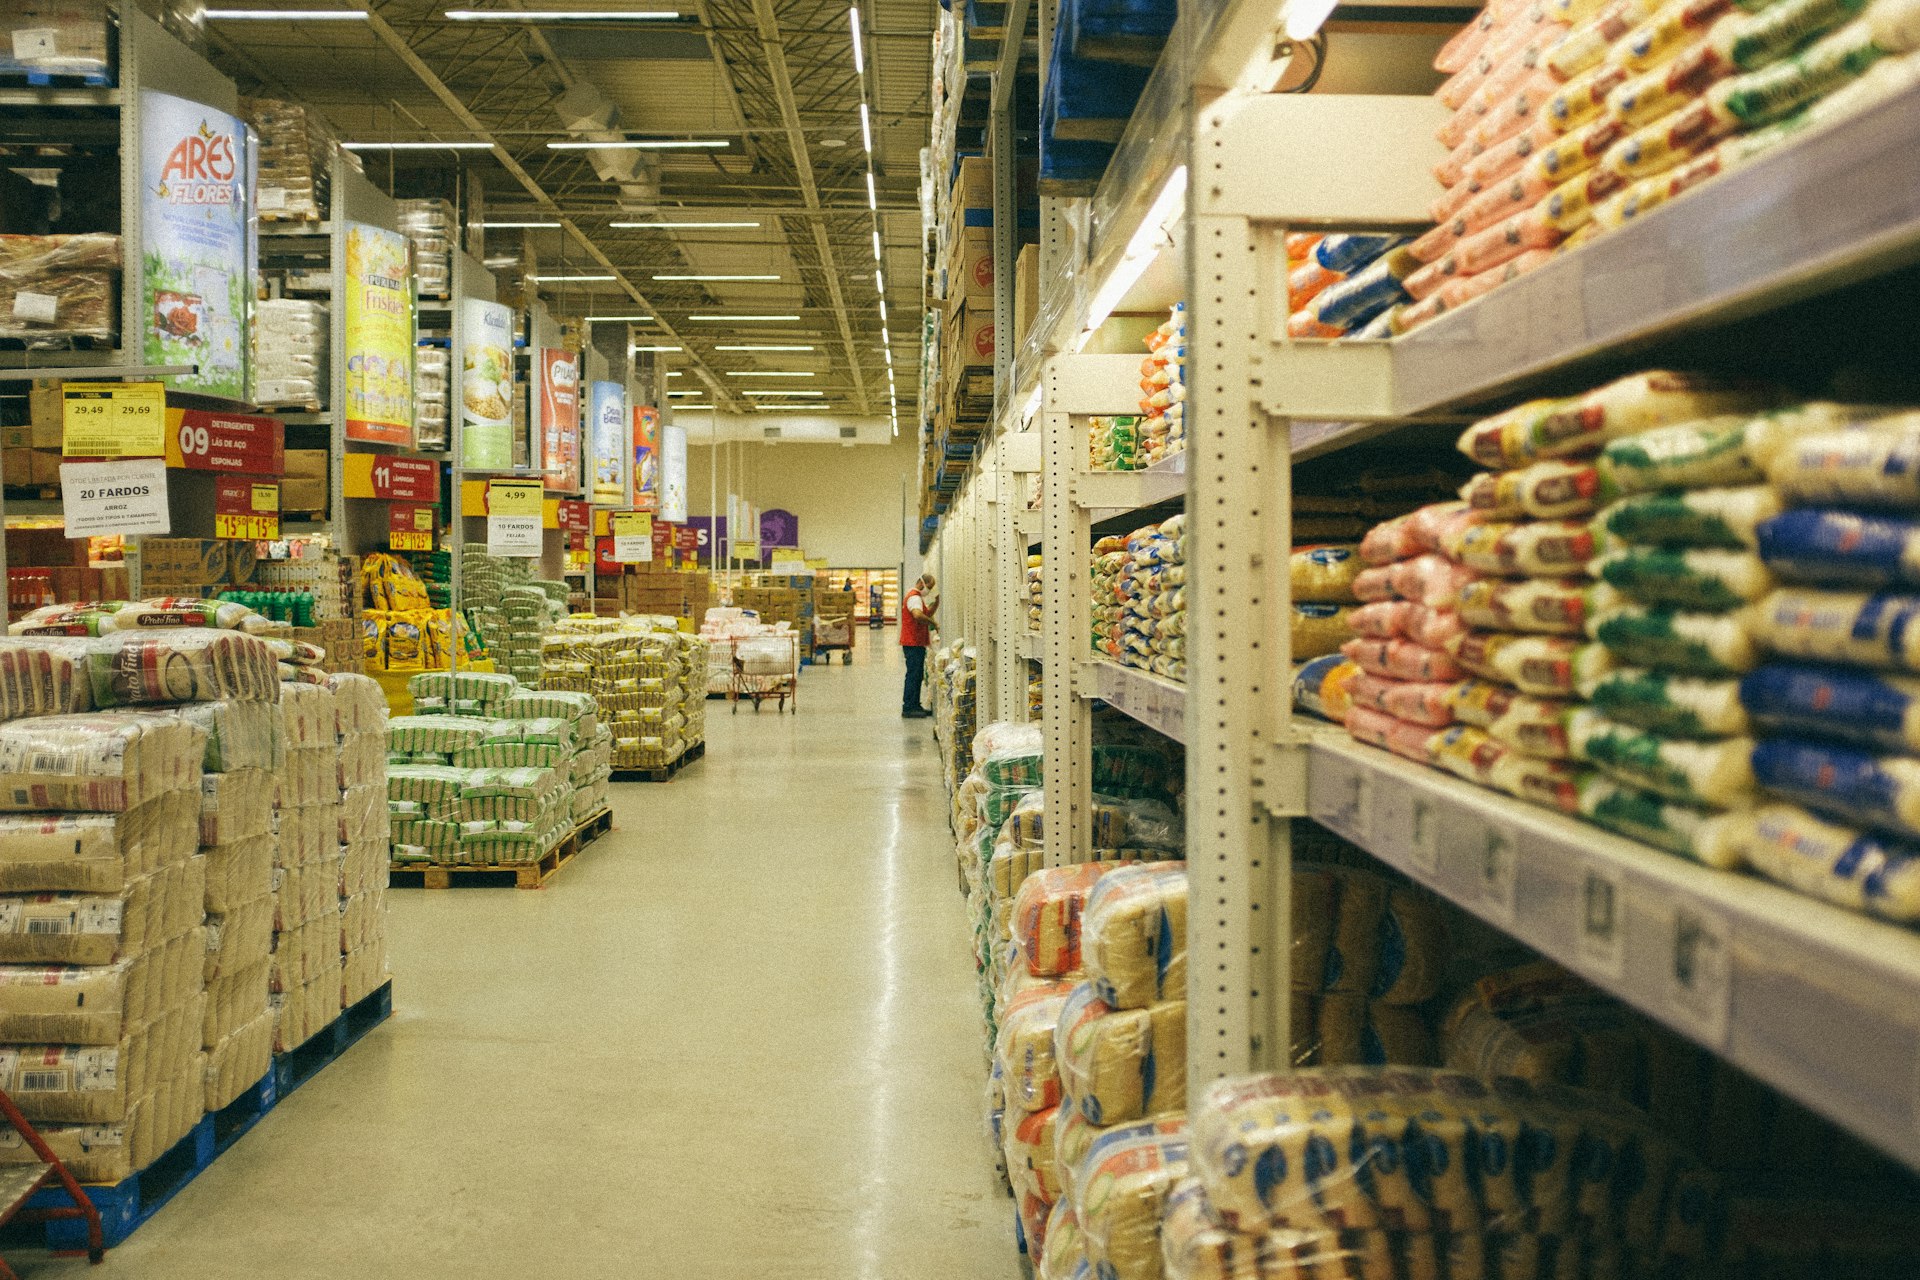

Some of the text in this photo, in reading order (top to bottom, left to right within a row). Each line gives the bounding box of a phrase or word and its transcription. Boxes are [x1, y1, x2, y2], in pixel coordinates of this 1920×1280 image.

[161, 135, 235, 181] ARES
[170, 183, 232, 205] FLORES
[369, 275, 399, 291] PURINA
[366, 290, 404, 315] Friskies
[74, 406, 150, 415] 29,49 29,69
[211, 420, 255, 432] DETERGENTES
[180, 425, 209, 455] 09
[224, 439, 233, 448] DE
[234, 441, 247, 450] AÇO
[211, 457, 243, 467] ESPONJAS
[374, 466, 390, 488] 11
[80, 485, 150, 499] 20 FARDOS
[505, 491, 526, 500] 4,99
[142, 613, 165, 625] Prato
[163, 613, 180, 624] Fino
[121, 643, 142, 678] Fino
